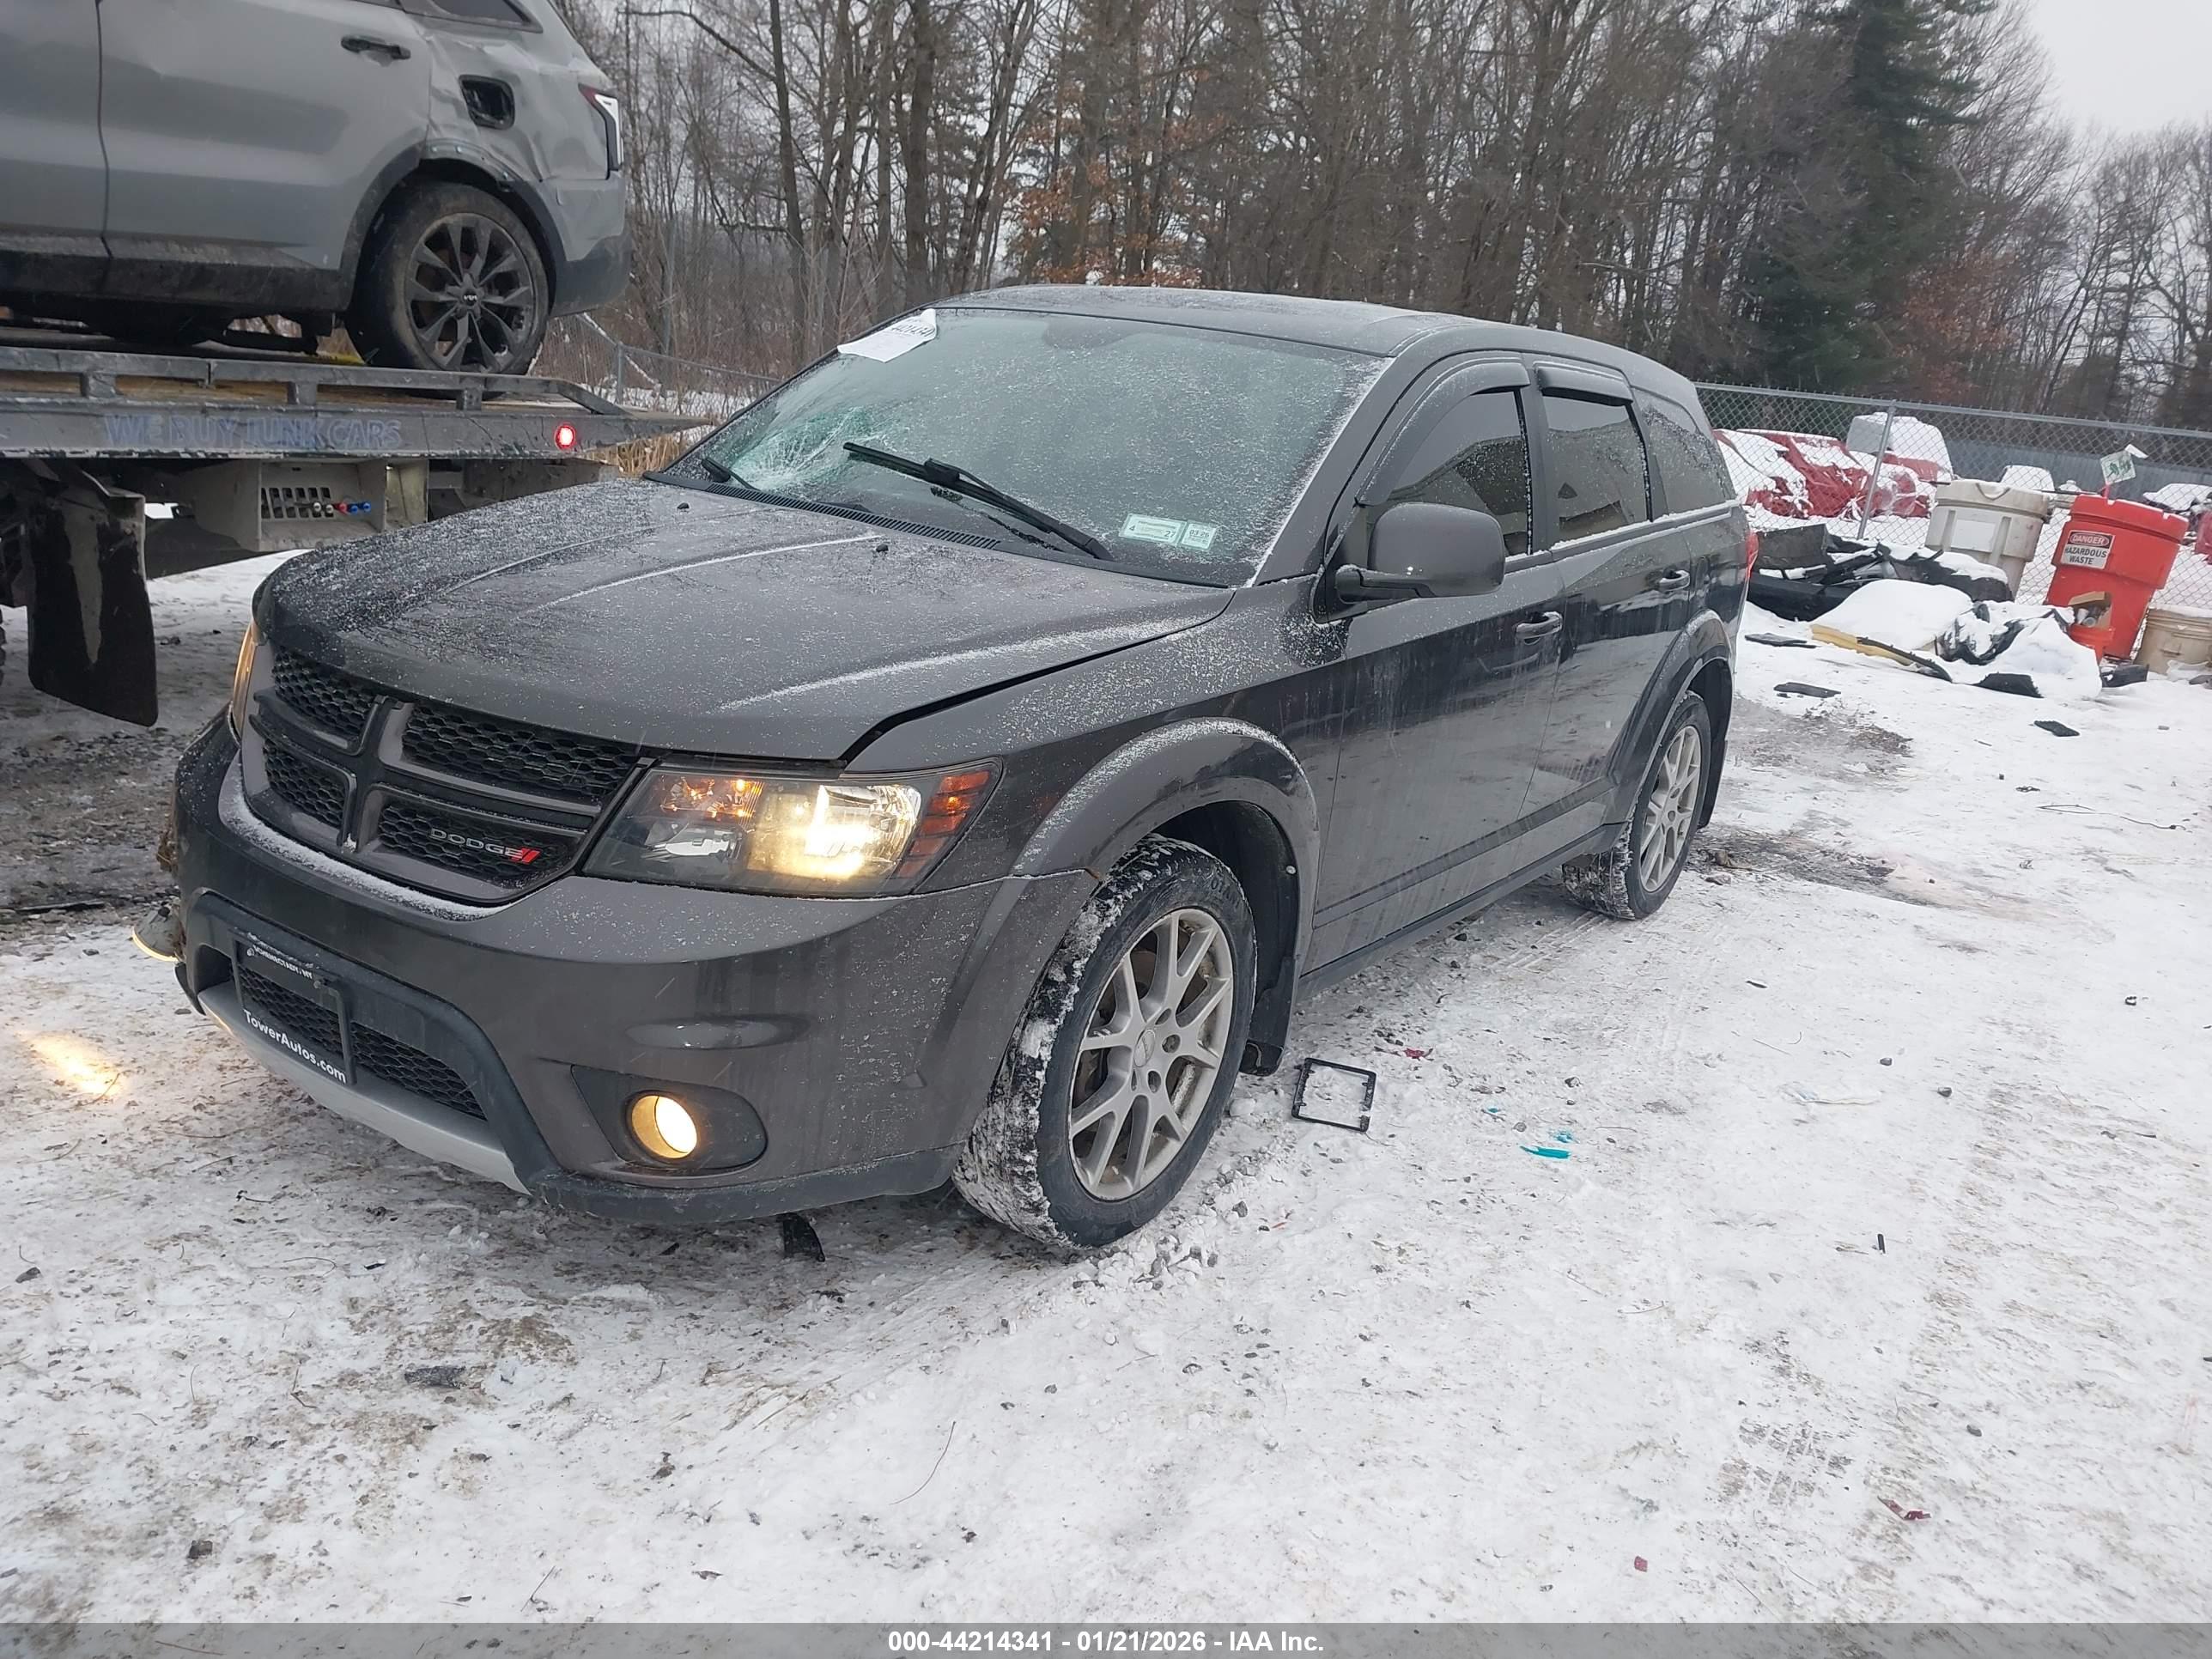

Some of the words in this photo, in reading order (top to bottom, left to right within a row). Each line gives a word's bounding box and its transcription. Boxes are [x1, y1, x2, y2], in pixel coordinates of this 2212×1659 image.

[103, 413, 163, 447] WE
[172, 416, 241, 448] BUY
[246, 416, 325, 449] JUNK
[328, 418, 402, 449] CARS
[2072, 534, 2106, 545] DANGER
[2065, 547, 2108, 558] HAZARDOUS
[2069, 555, 2095, 565] WASTE
[430, 828, 524, 860] DODGE
[243, 1008, 348, 1085] TowerAutos.com
